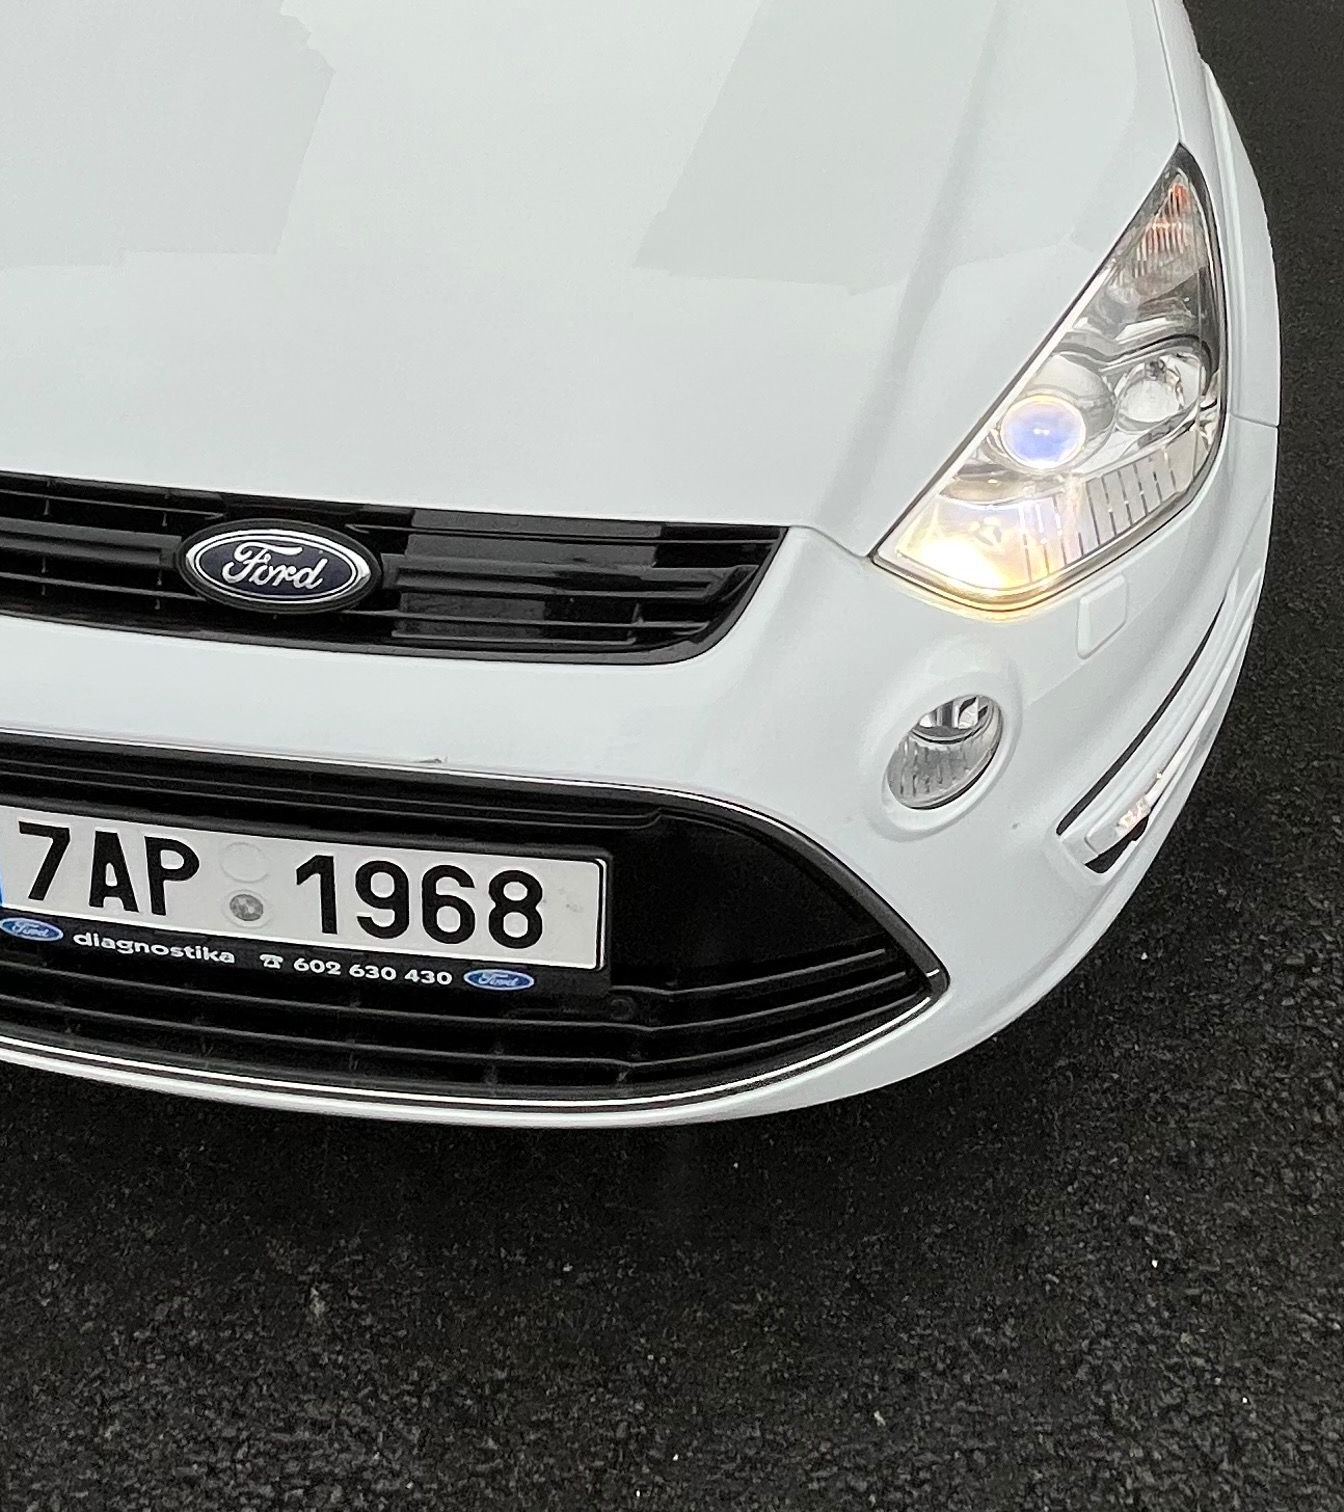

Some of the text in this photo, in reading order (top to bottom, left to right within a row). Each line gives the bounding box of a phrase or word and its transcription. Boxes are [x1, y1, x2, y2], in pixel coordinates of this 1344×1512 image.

[222, 541, 328, 589] Ford
[18, 820, 543, 949] 7AP 1968
[8, 918, 522, 989] Ford diagnostika 602 630 430 Ford
